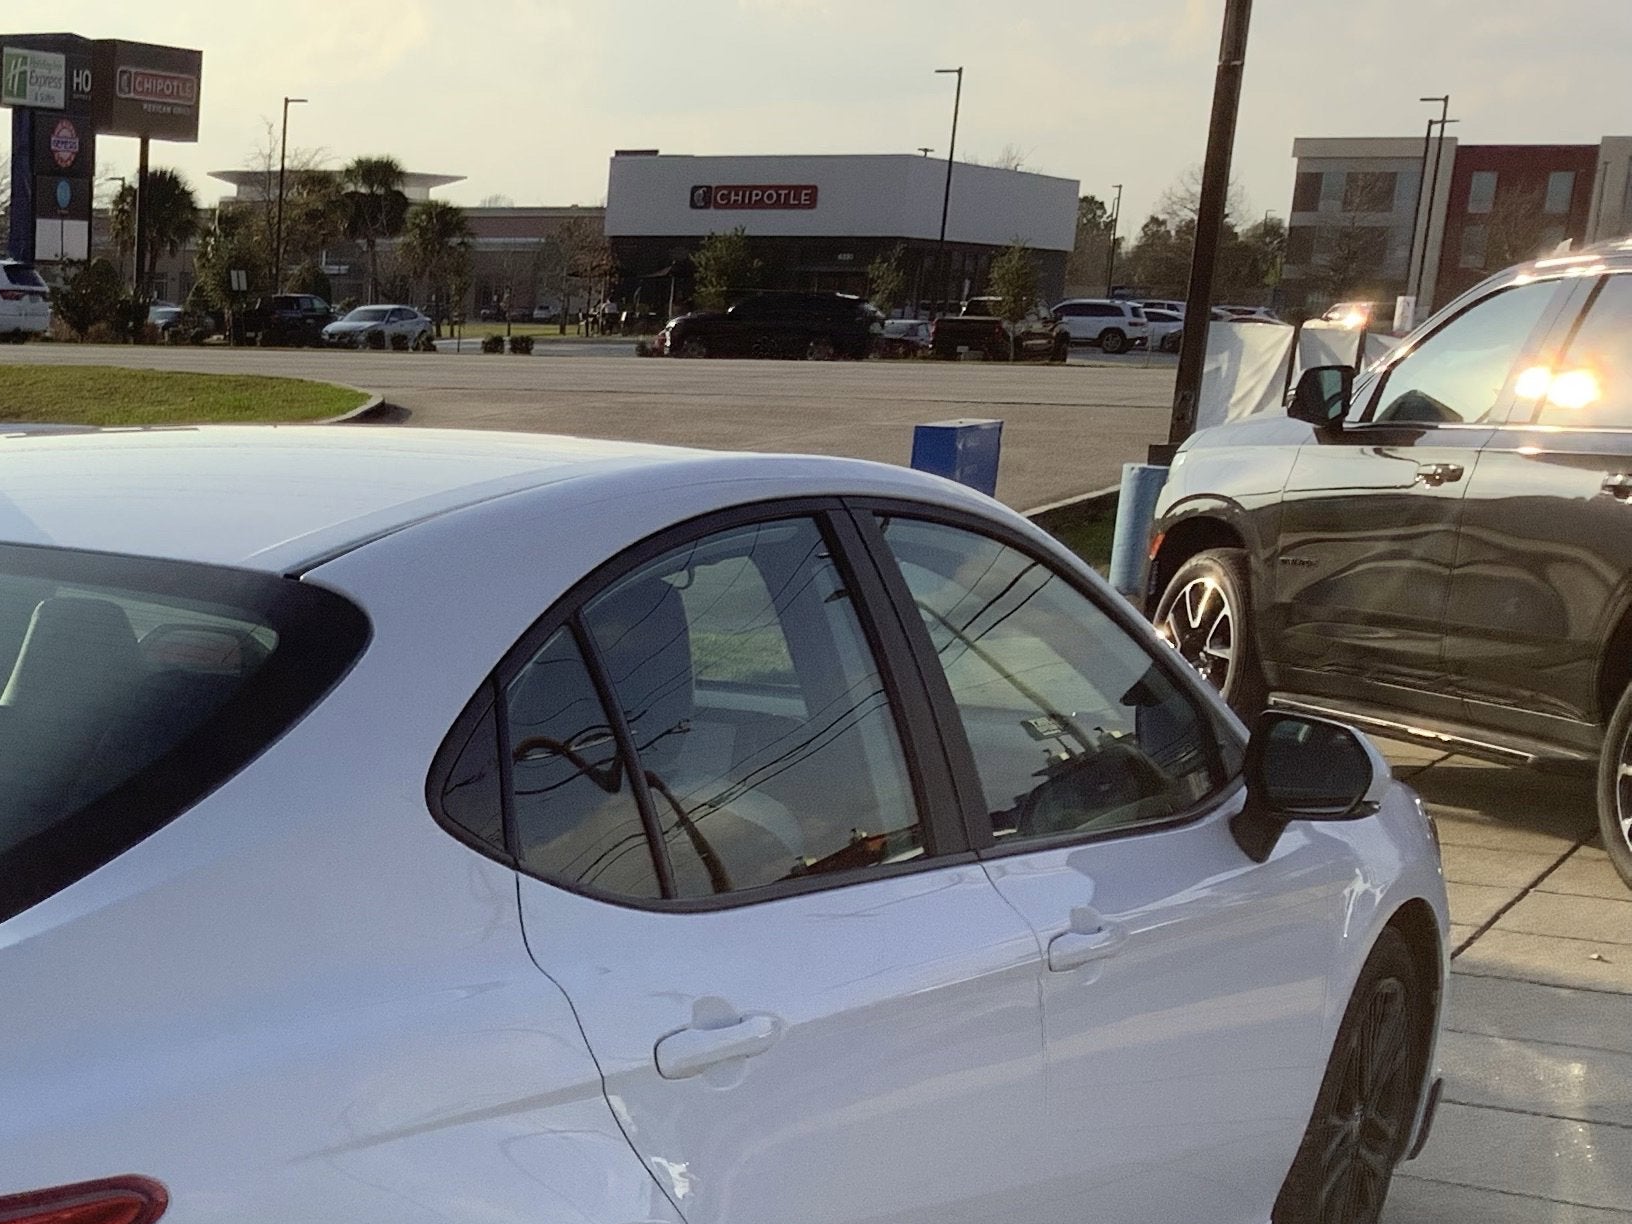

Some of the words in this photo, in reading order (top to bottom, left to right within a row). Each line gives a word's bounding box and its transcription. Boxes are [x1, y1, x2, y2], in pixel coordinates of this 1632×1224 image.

[29, 70, 62, 91] Express
[135, 77, 193, 98] CHIPOTLE
[717, 189, 812, 205] CHIPOTLE
